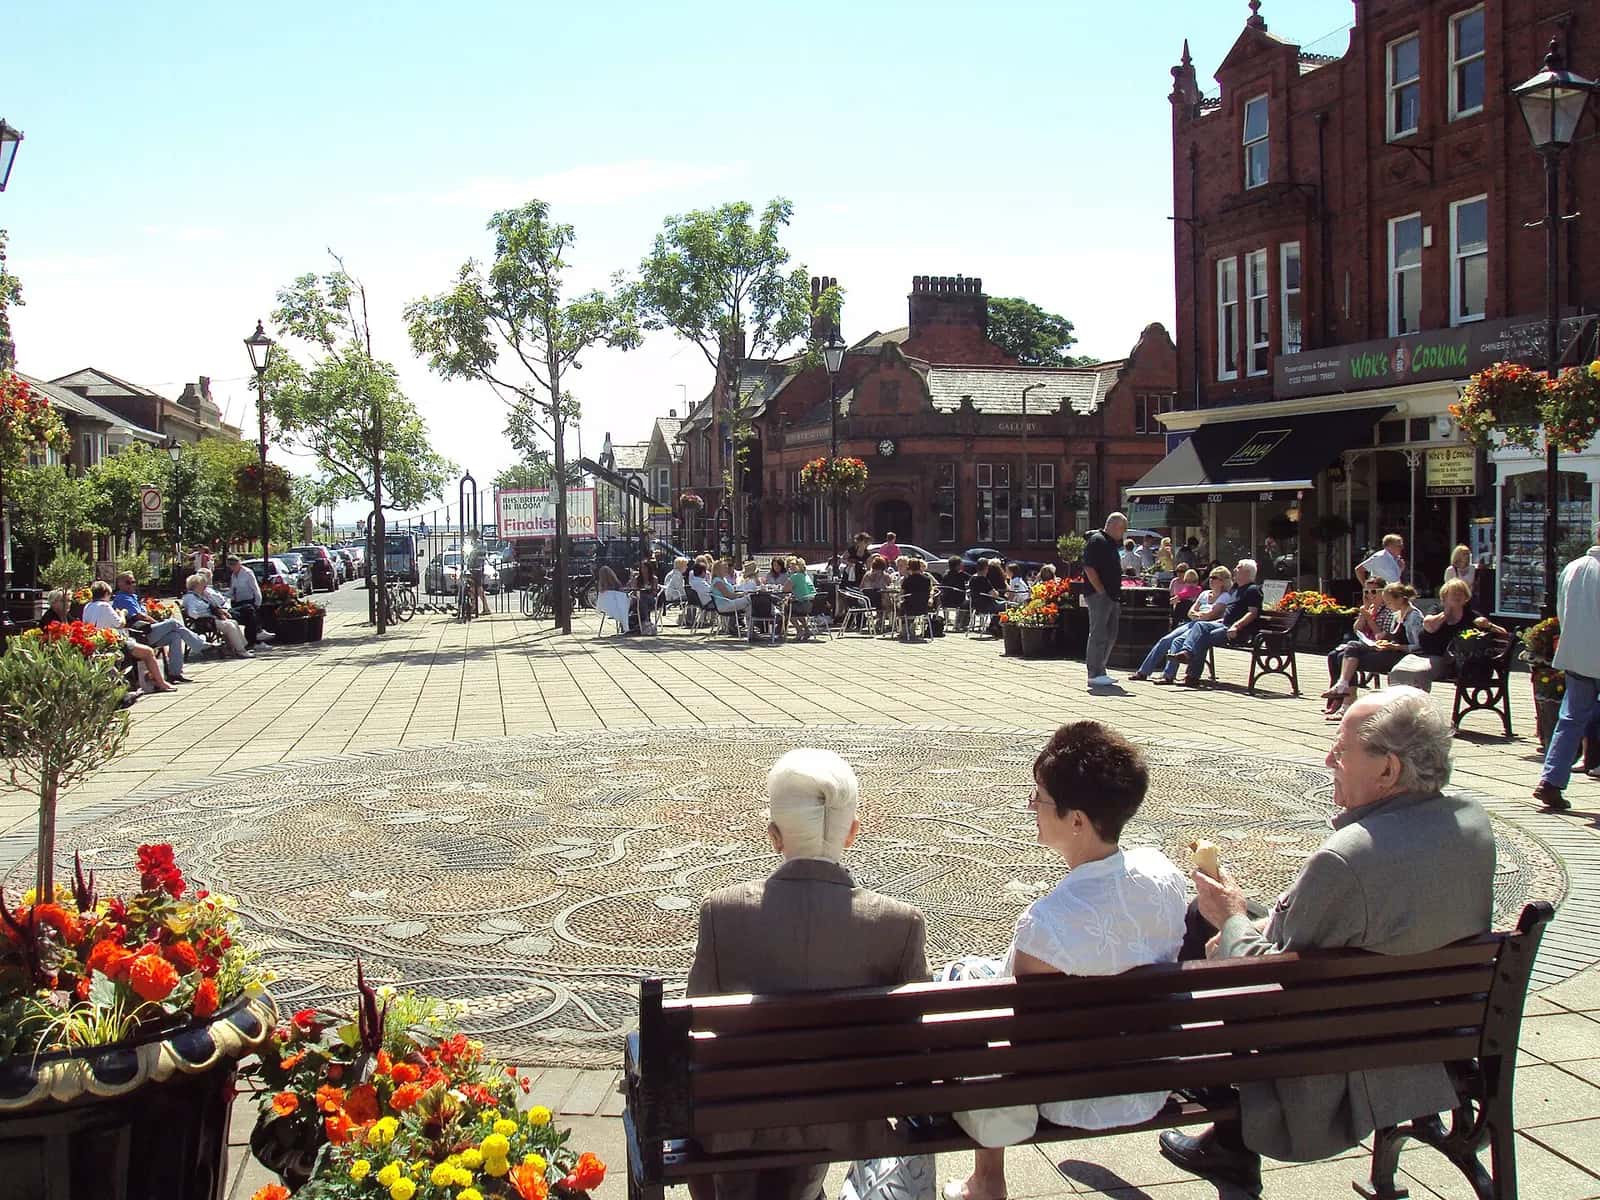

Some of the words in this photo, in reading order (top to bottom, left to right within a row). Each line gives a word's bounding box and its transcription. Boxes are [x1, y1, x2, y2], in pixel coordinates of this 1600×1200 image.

[514, 502, 541, 510] BLOOM
[503, 517, 556, 531] Finalist
[567, 515, 592, 528] 010
